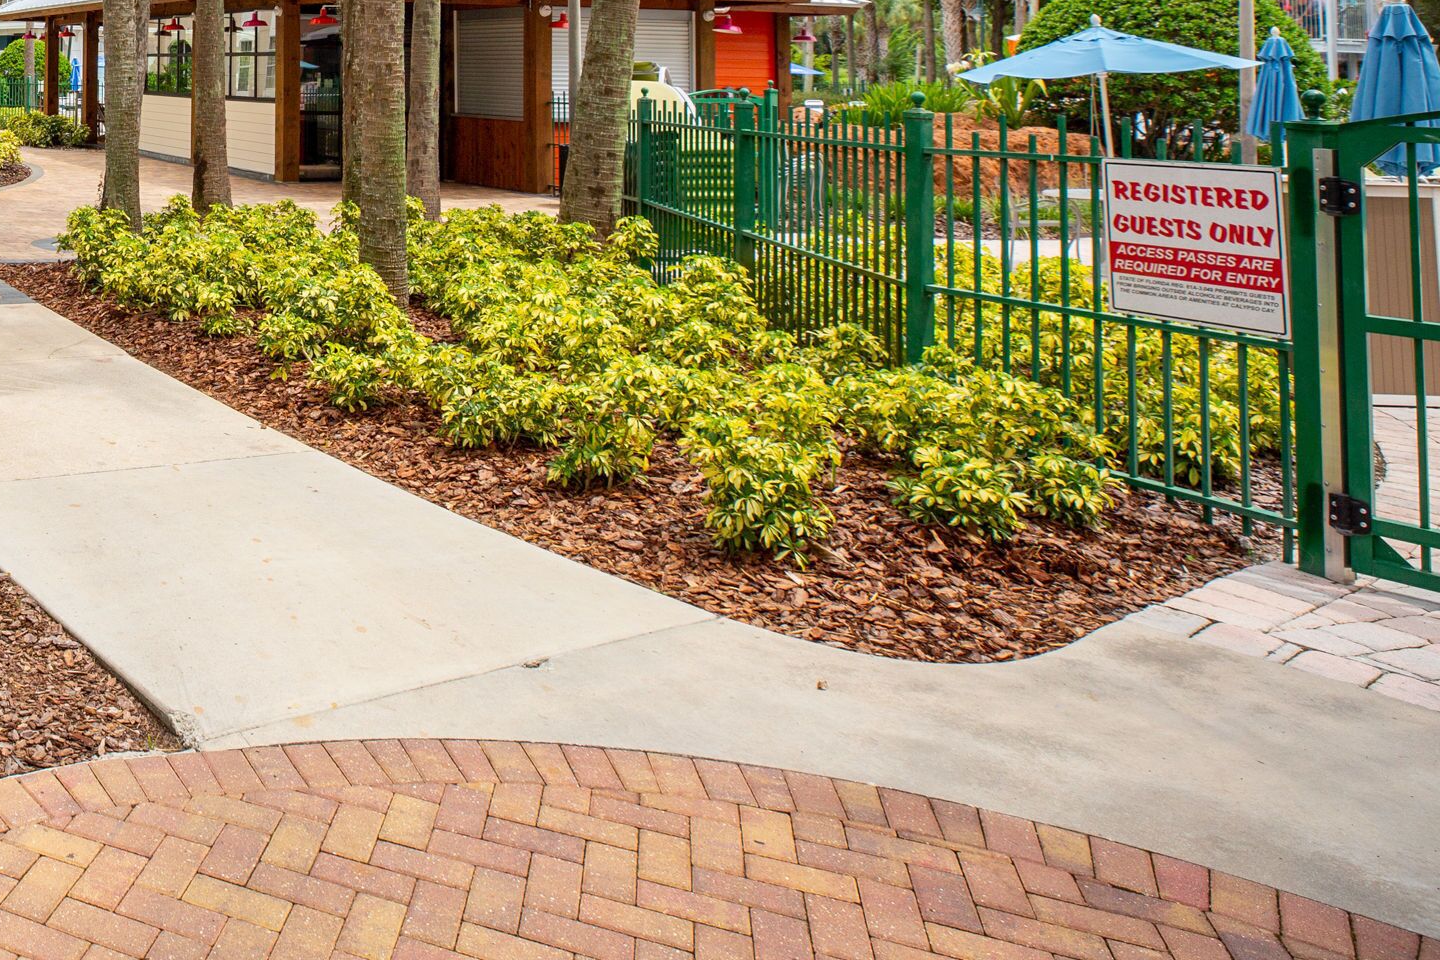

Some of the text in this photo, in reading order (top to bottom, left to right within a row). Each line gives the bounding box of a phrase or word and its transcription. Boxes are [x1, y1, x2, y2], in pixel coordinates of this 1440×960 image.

[1112, 180, 1269, 211] REGISTERED
[1113, 213, 1274, 248] GUESTS ONLY
[1116, 244, 1274, 272] ACCESS PASSES ARE
[1114, 258, 1280, 289] REQUIRED FOR ENTRY
[1131, 289, 1157, 297] COMMON
[1230, 303, 1261, 312] CALYPSO
[1133, 283, 1160, 291] BRINGING
[1161, 287, 1186, 295] OUTSIDE
[1188, 290, 1223, 300] ALCOHOLIC
[1223, 295, 1262, 306] BEVERAGES
[1145, 278, 1170, 287] FLORIDA
[1248, 292, 1275, 301] GUESTS
